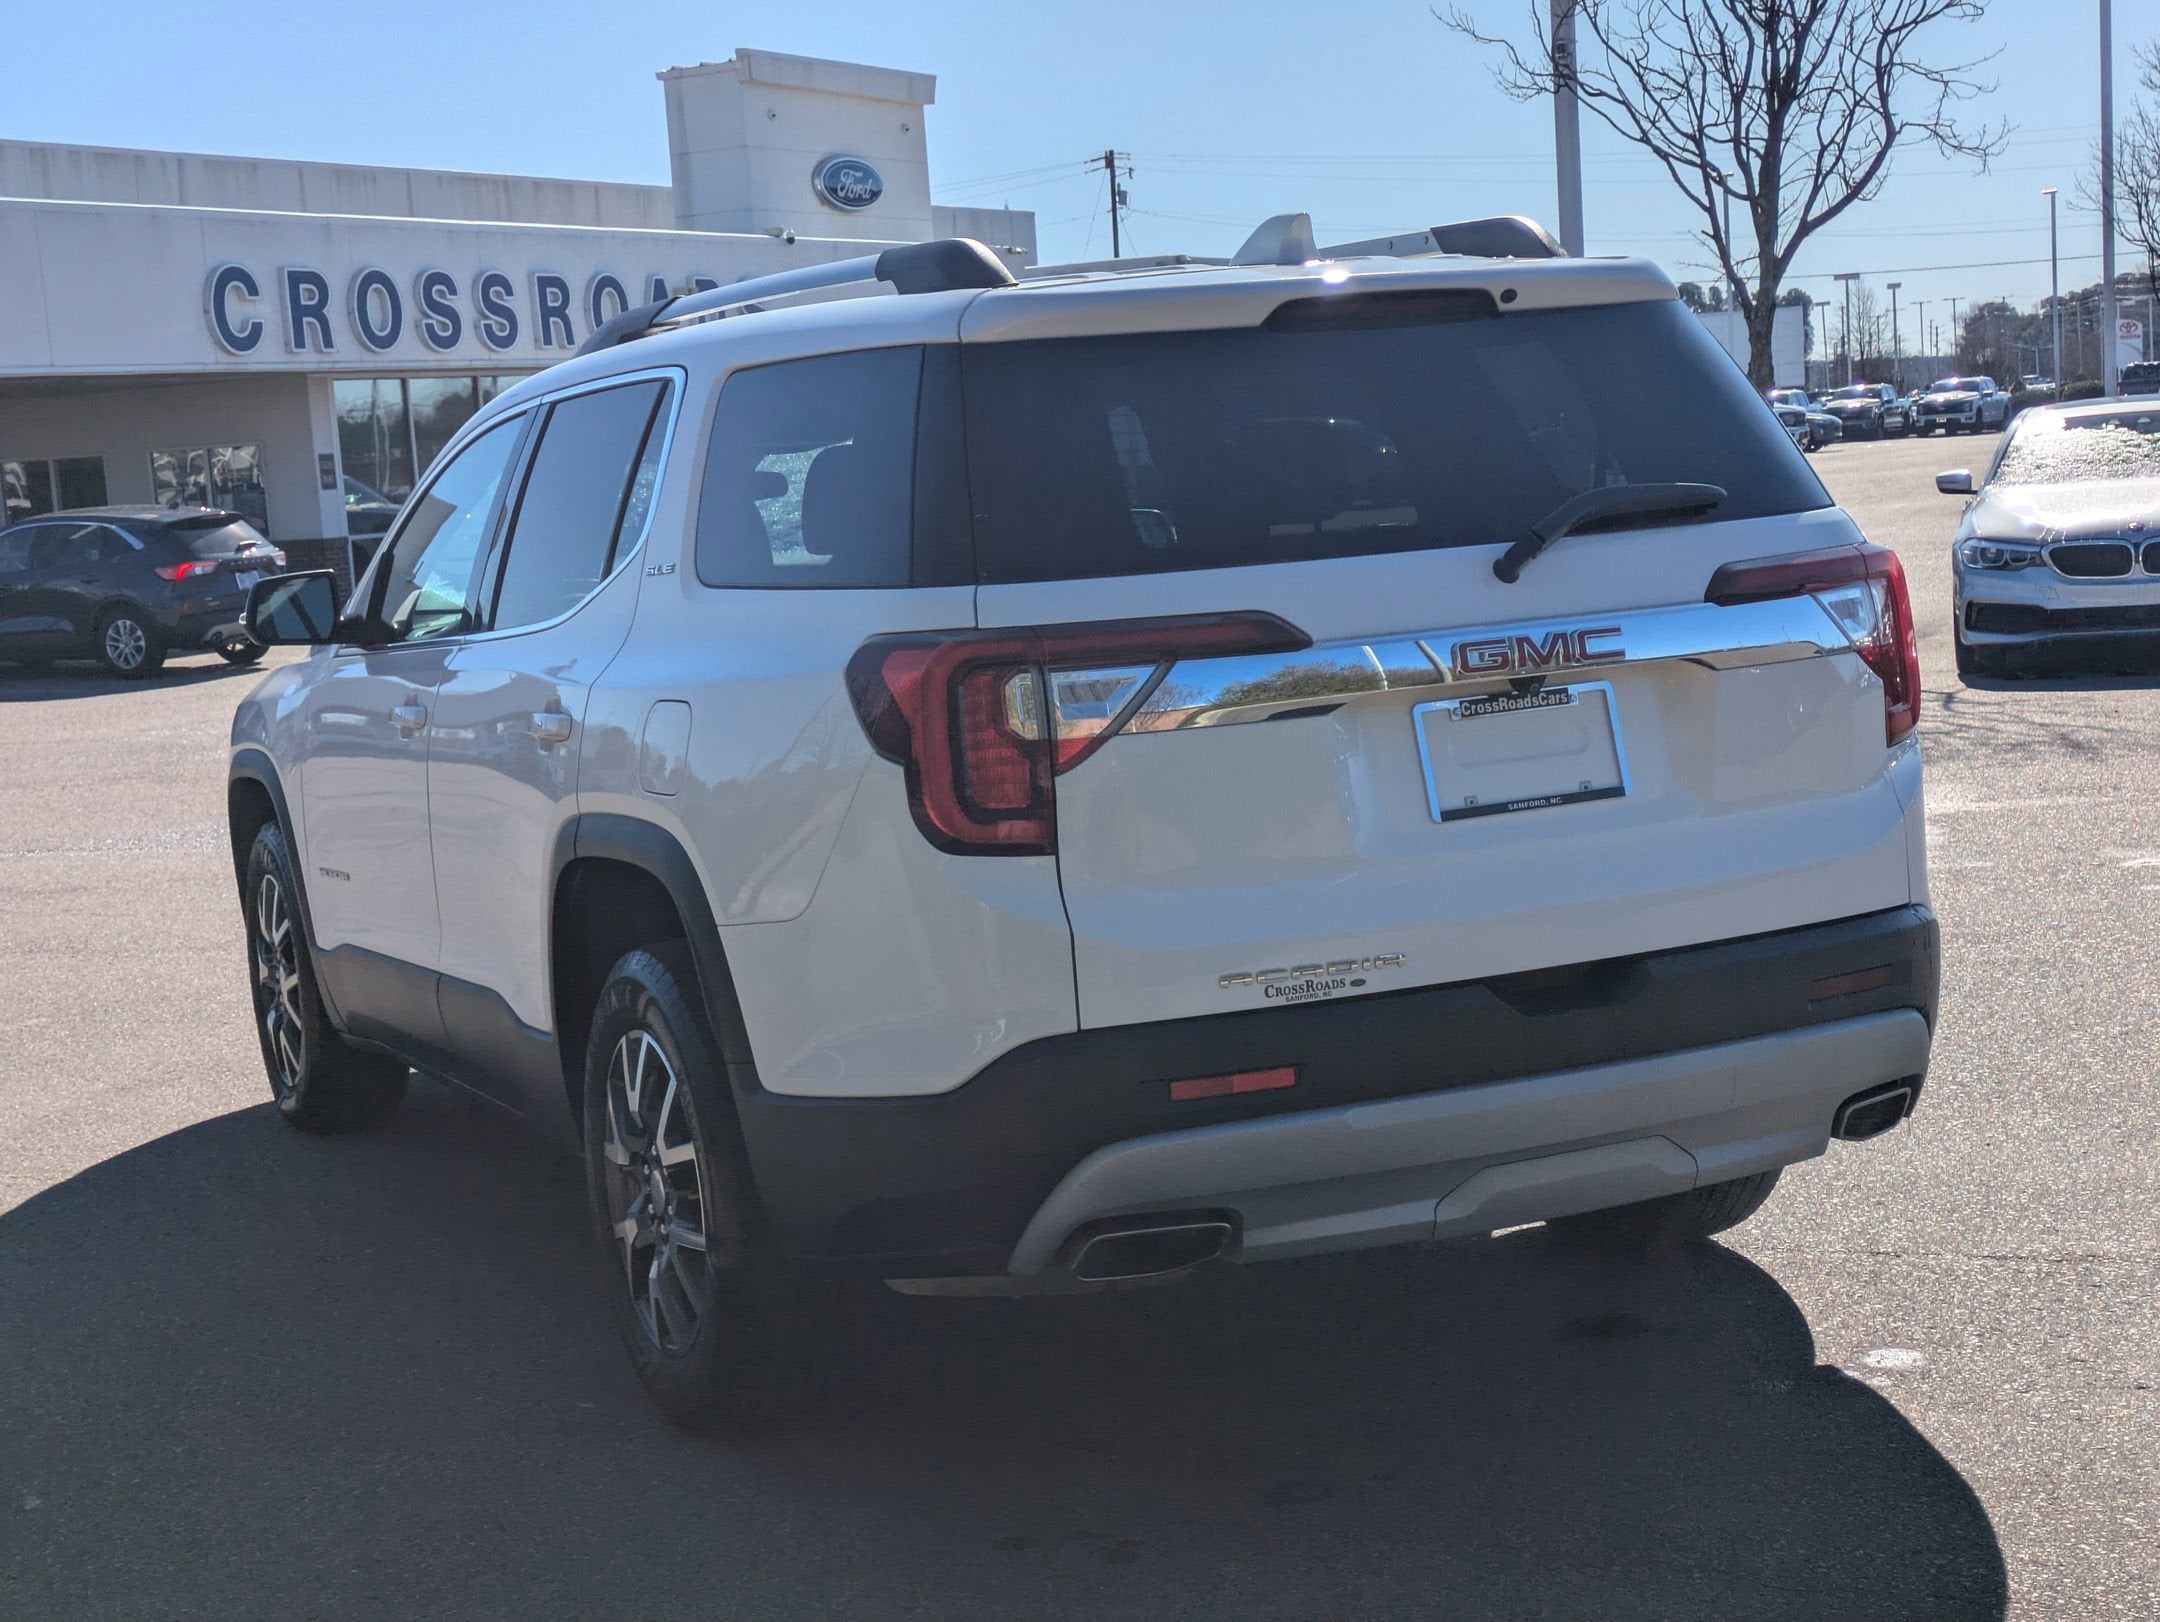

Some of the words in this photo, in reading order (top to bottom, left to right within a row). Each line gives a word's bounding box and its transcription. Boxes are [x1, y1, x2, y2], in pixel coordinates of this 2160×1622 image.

[837, 168, 873, 199] Ford
[204, 263, 767, 355] CROSSRO
[646, 562, 676, 576] SLE
[1452, 625, 1626, 675] GMC
[1461, 691, 1569, 717] CrossRoadsCars
[1550, 796, 1563, 805] NC
[1219, 952, 1408, 989] ACADIA
